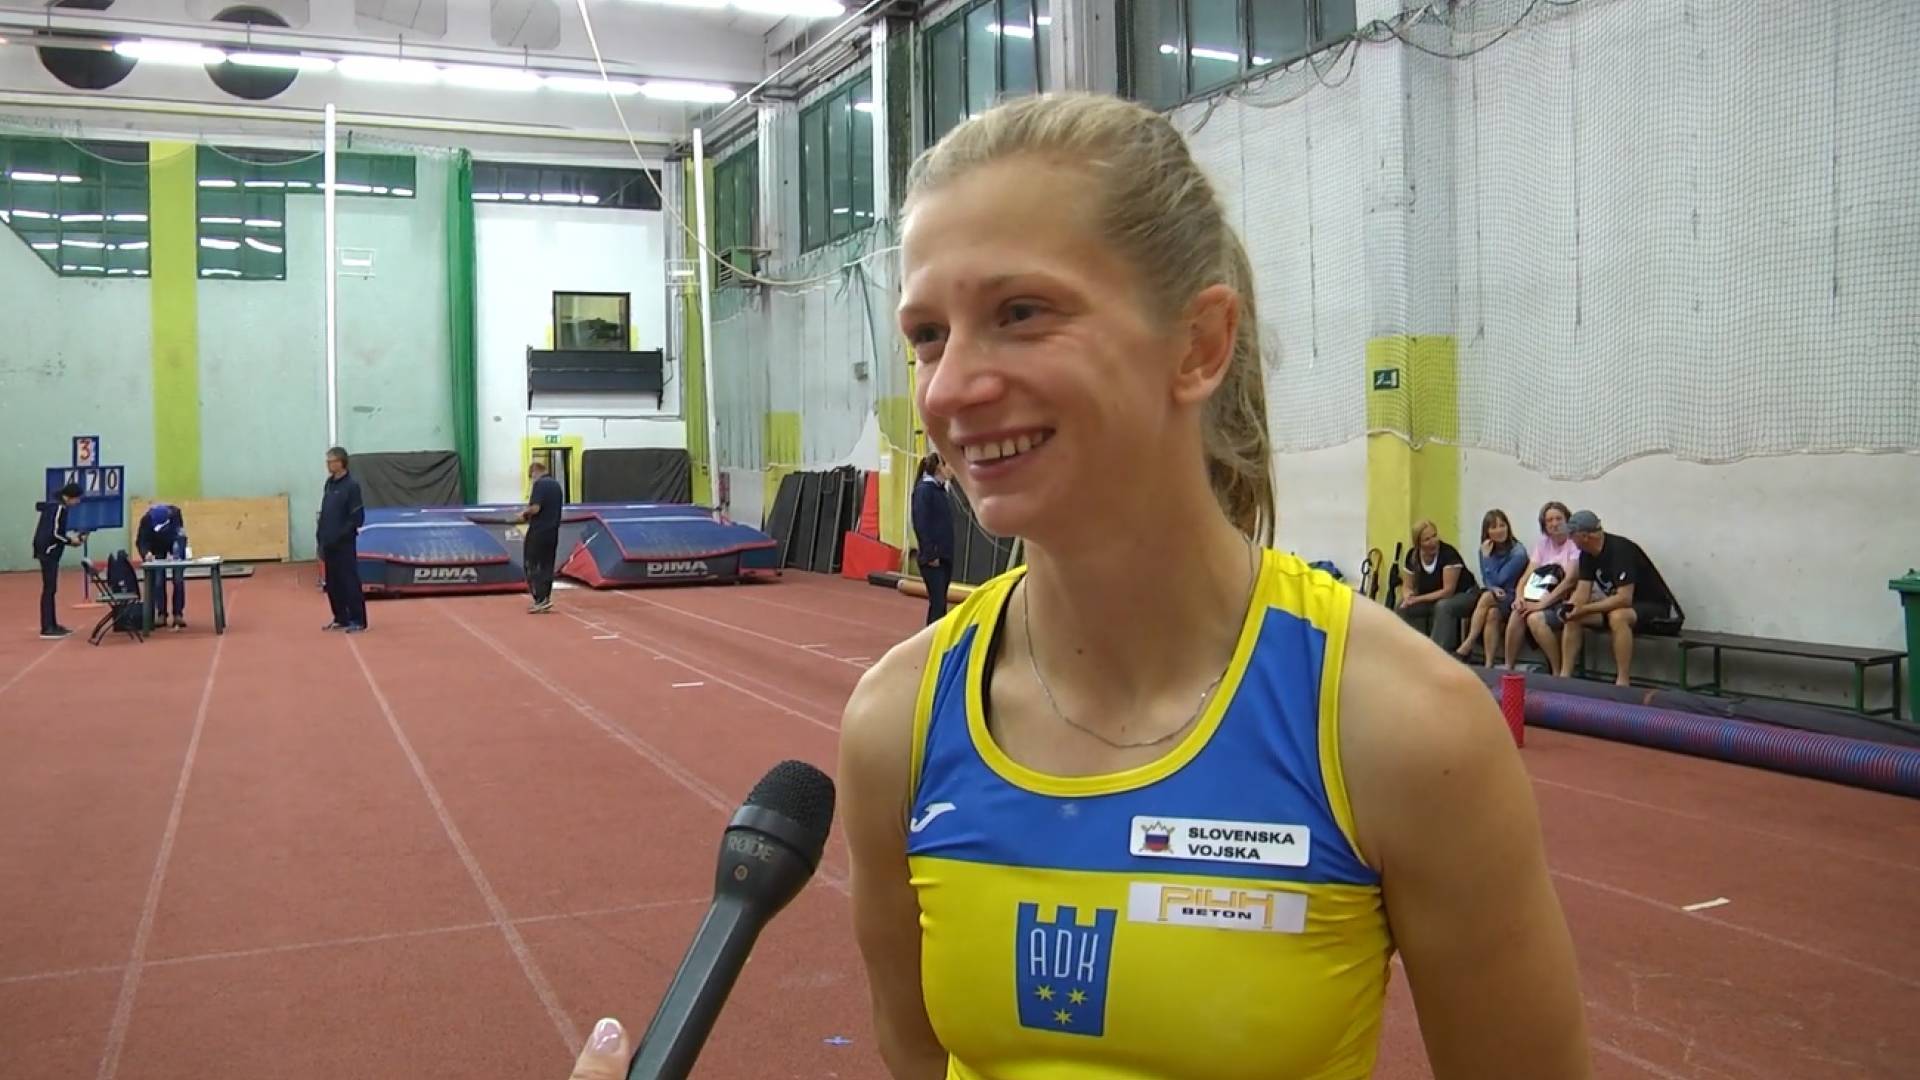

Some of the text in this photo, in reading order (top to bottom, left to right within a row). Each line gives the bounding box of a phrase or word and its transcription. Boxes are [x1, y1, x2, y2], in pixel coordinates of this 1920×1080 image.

[79, 439, 91, 460] 3
[414, 567, 477, 578] DIMA
[647, 561, 708, 573] DIMA
[1188, 827, 1295, 845] SLOVENSKA
[1188, 843, 1260, 860] VOJSKA
[1182, 907, 1252, 920] BETON
[1030, 927, 1099, 983] ADK
